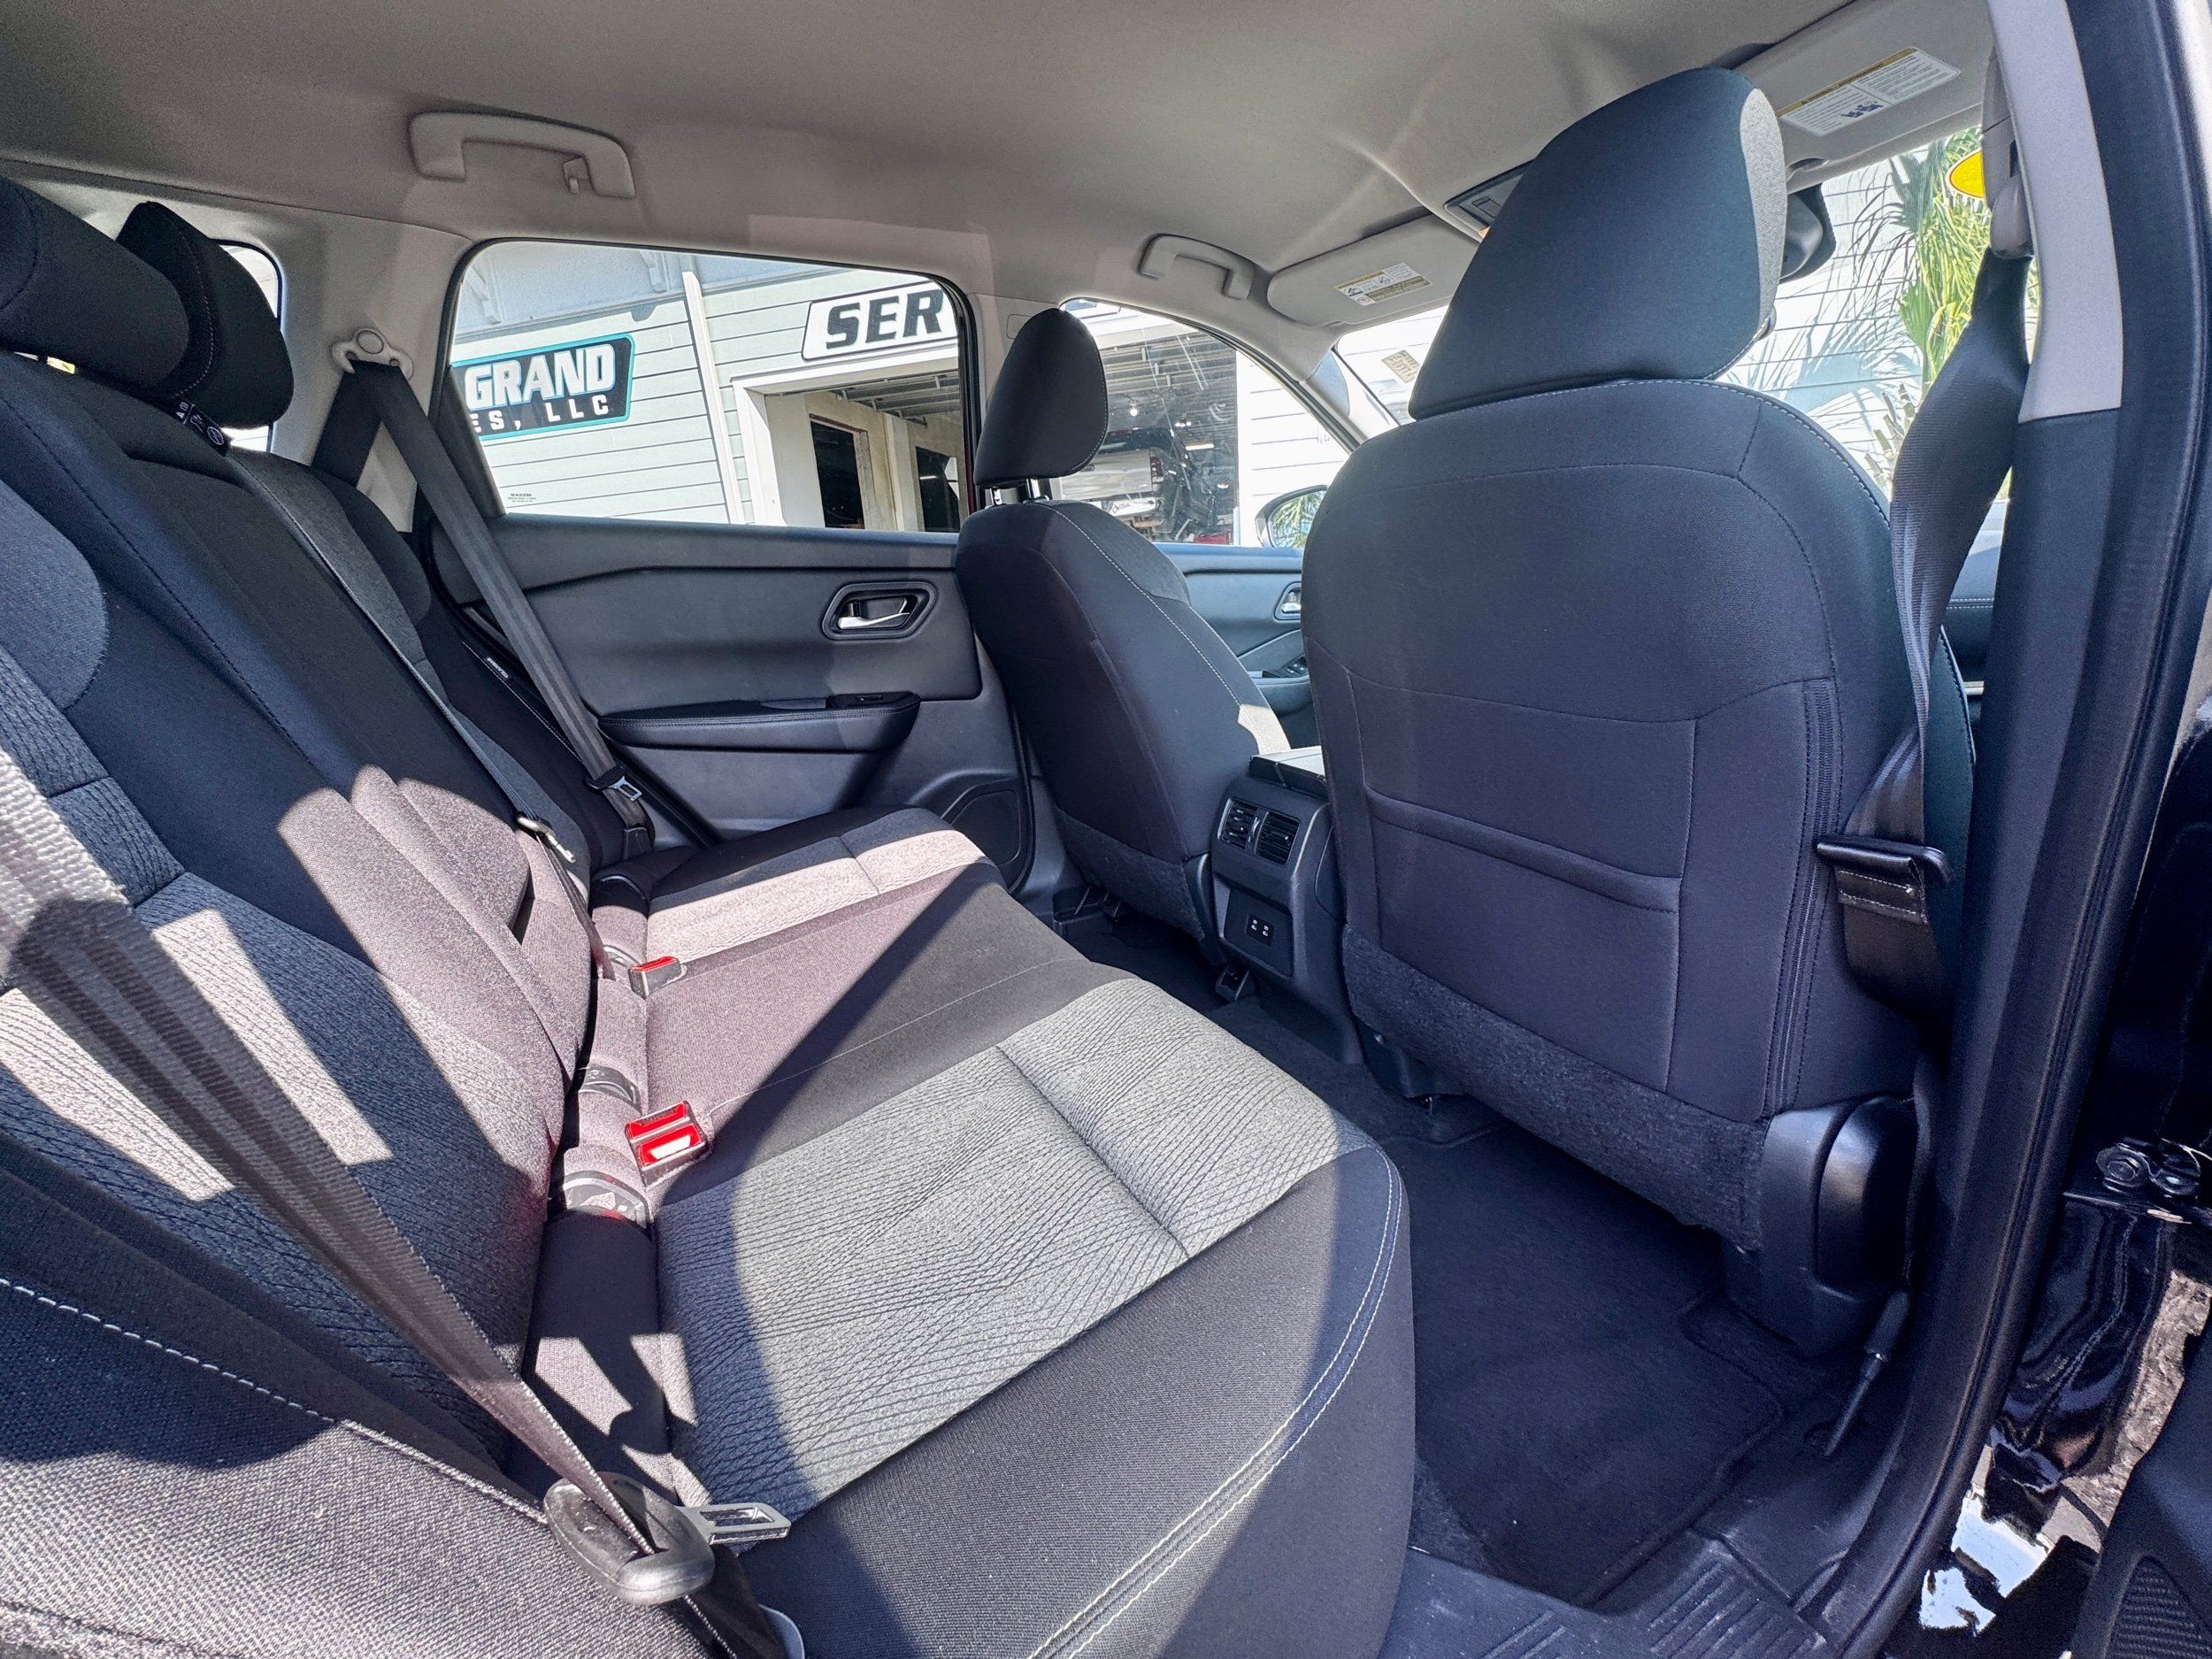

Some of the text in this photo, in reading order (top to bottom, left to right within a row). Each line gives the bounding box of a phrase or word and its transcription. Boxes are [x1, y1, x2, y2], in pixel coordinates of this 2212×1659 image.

[826, 288, 944, 349] SER
[465, 343, 617, 411] GRAND
[545, 395, 609, 423] LLC
